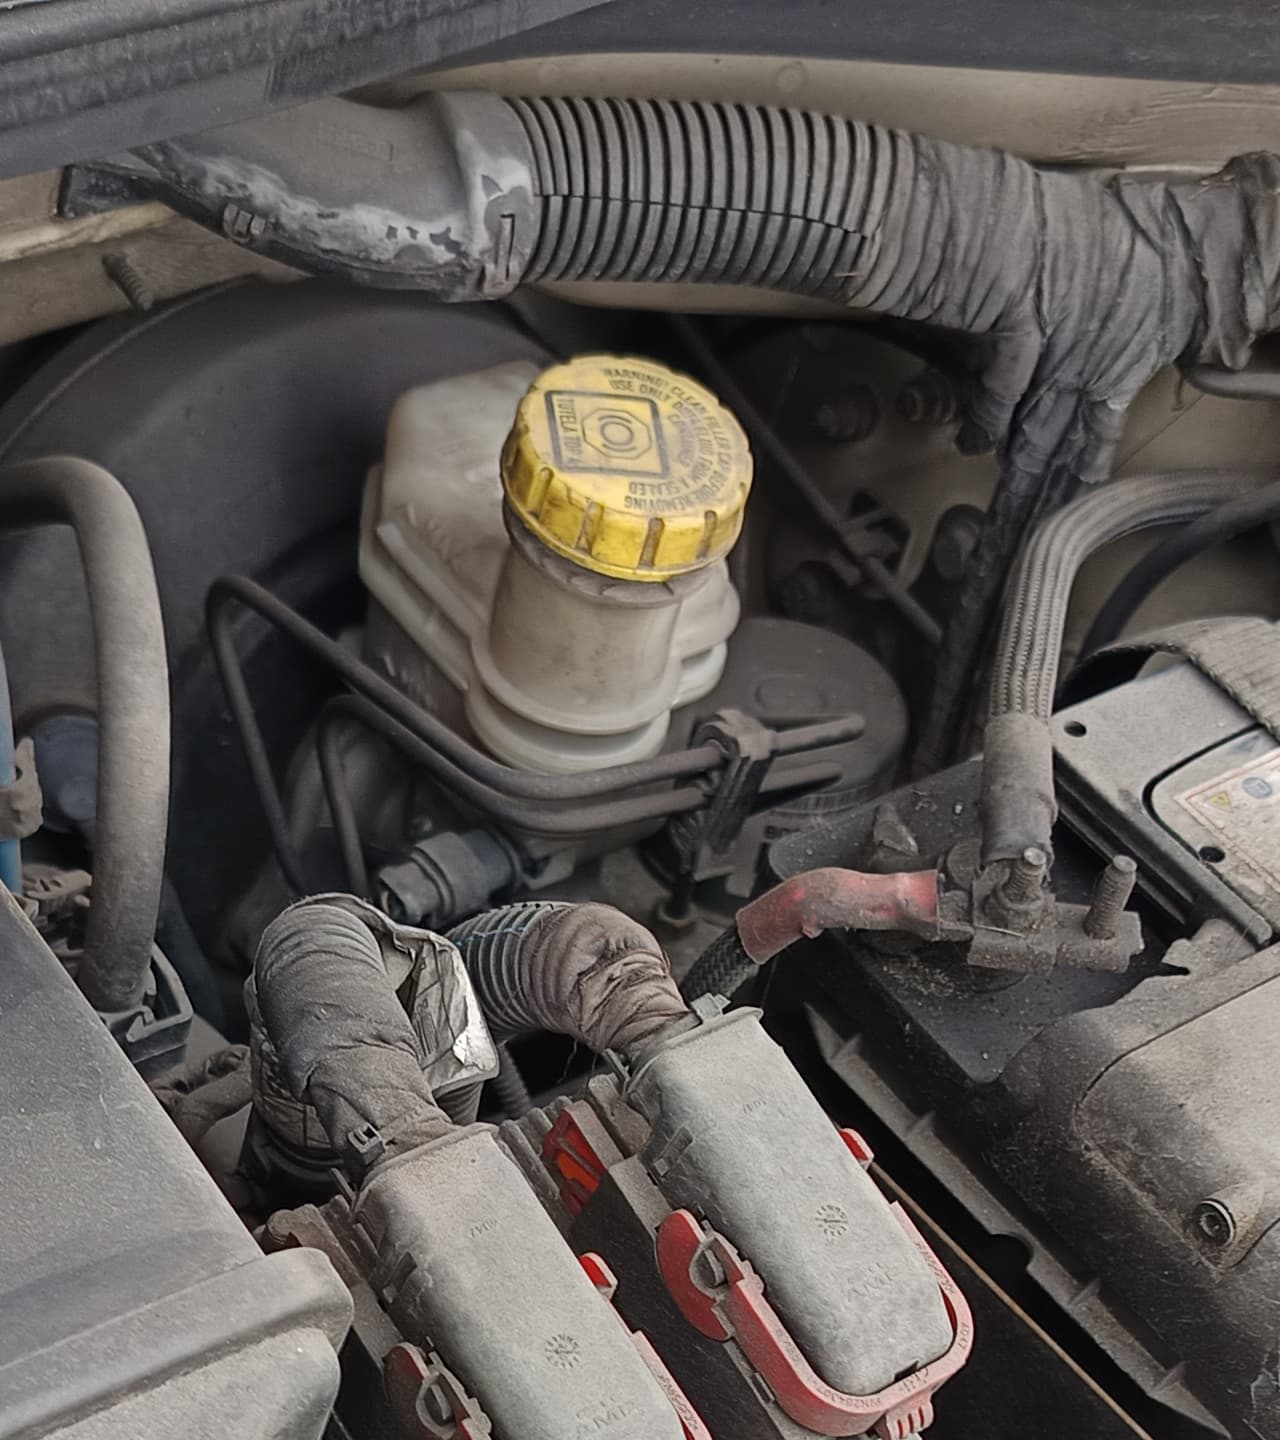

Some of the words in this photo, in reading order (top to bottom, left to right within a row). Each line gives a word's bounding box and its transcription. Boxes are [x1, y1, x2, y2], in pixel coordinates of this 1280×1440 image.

[609, 379, 634, 391] USE
[639, 384, 671, 401] ONLY
[671, 386, 706, 413] CLEAN
[555, 398, 578, 432] TUTELA
[704, 416, 731, 452] FILLER
[629, 481, 680, 496] SEALED
[624, 494, 694, 511] REMOVING
